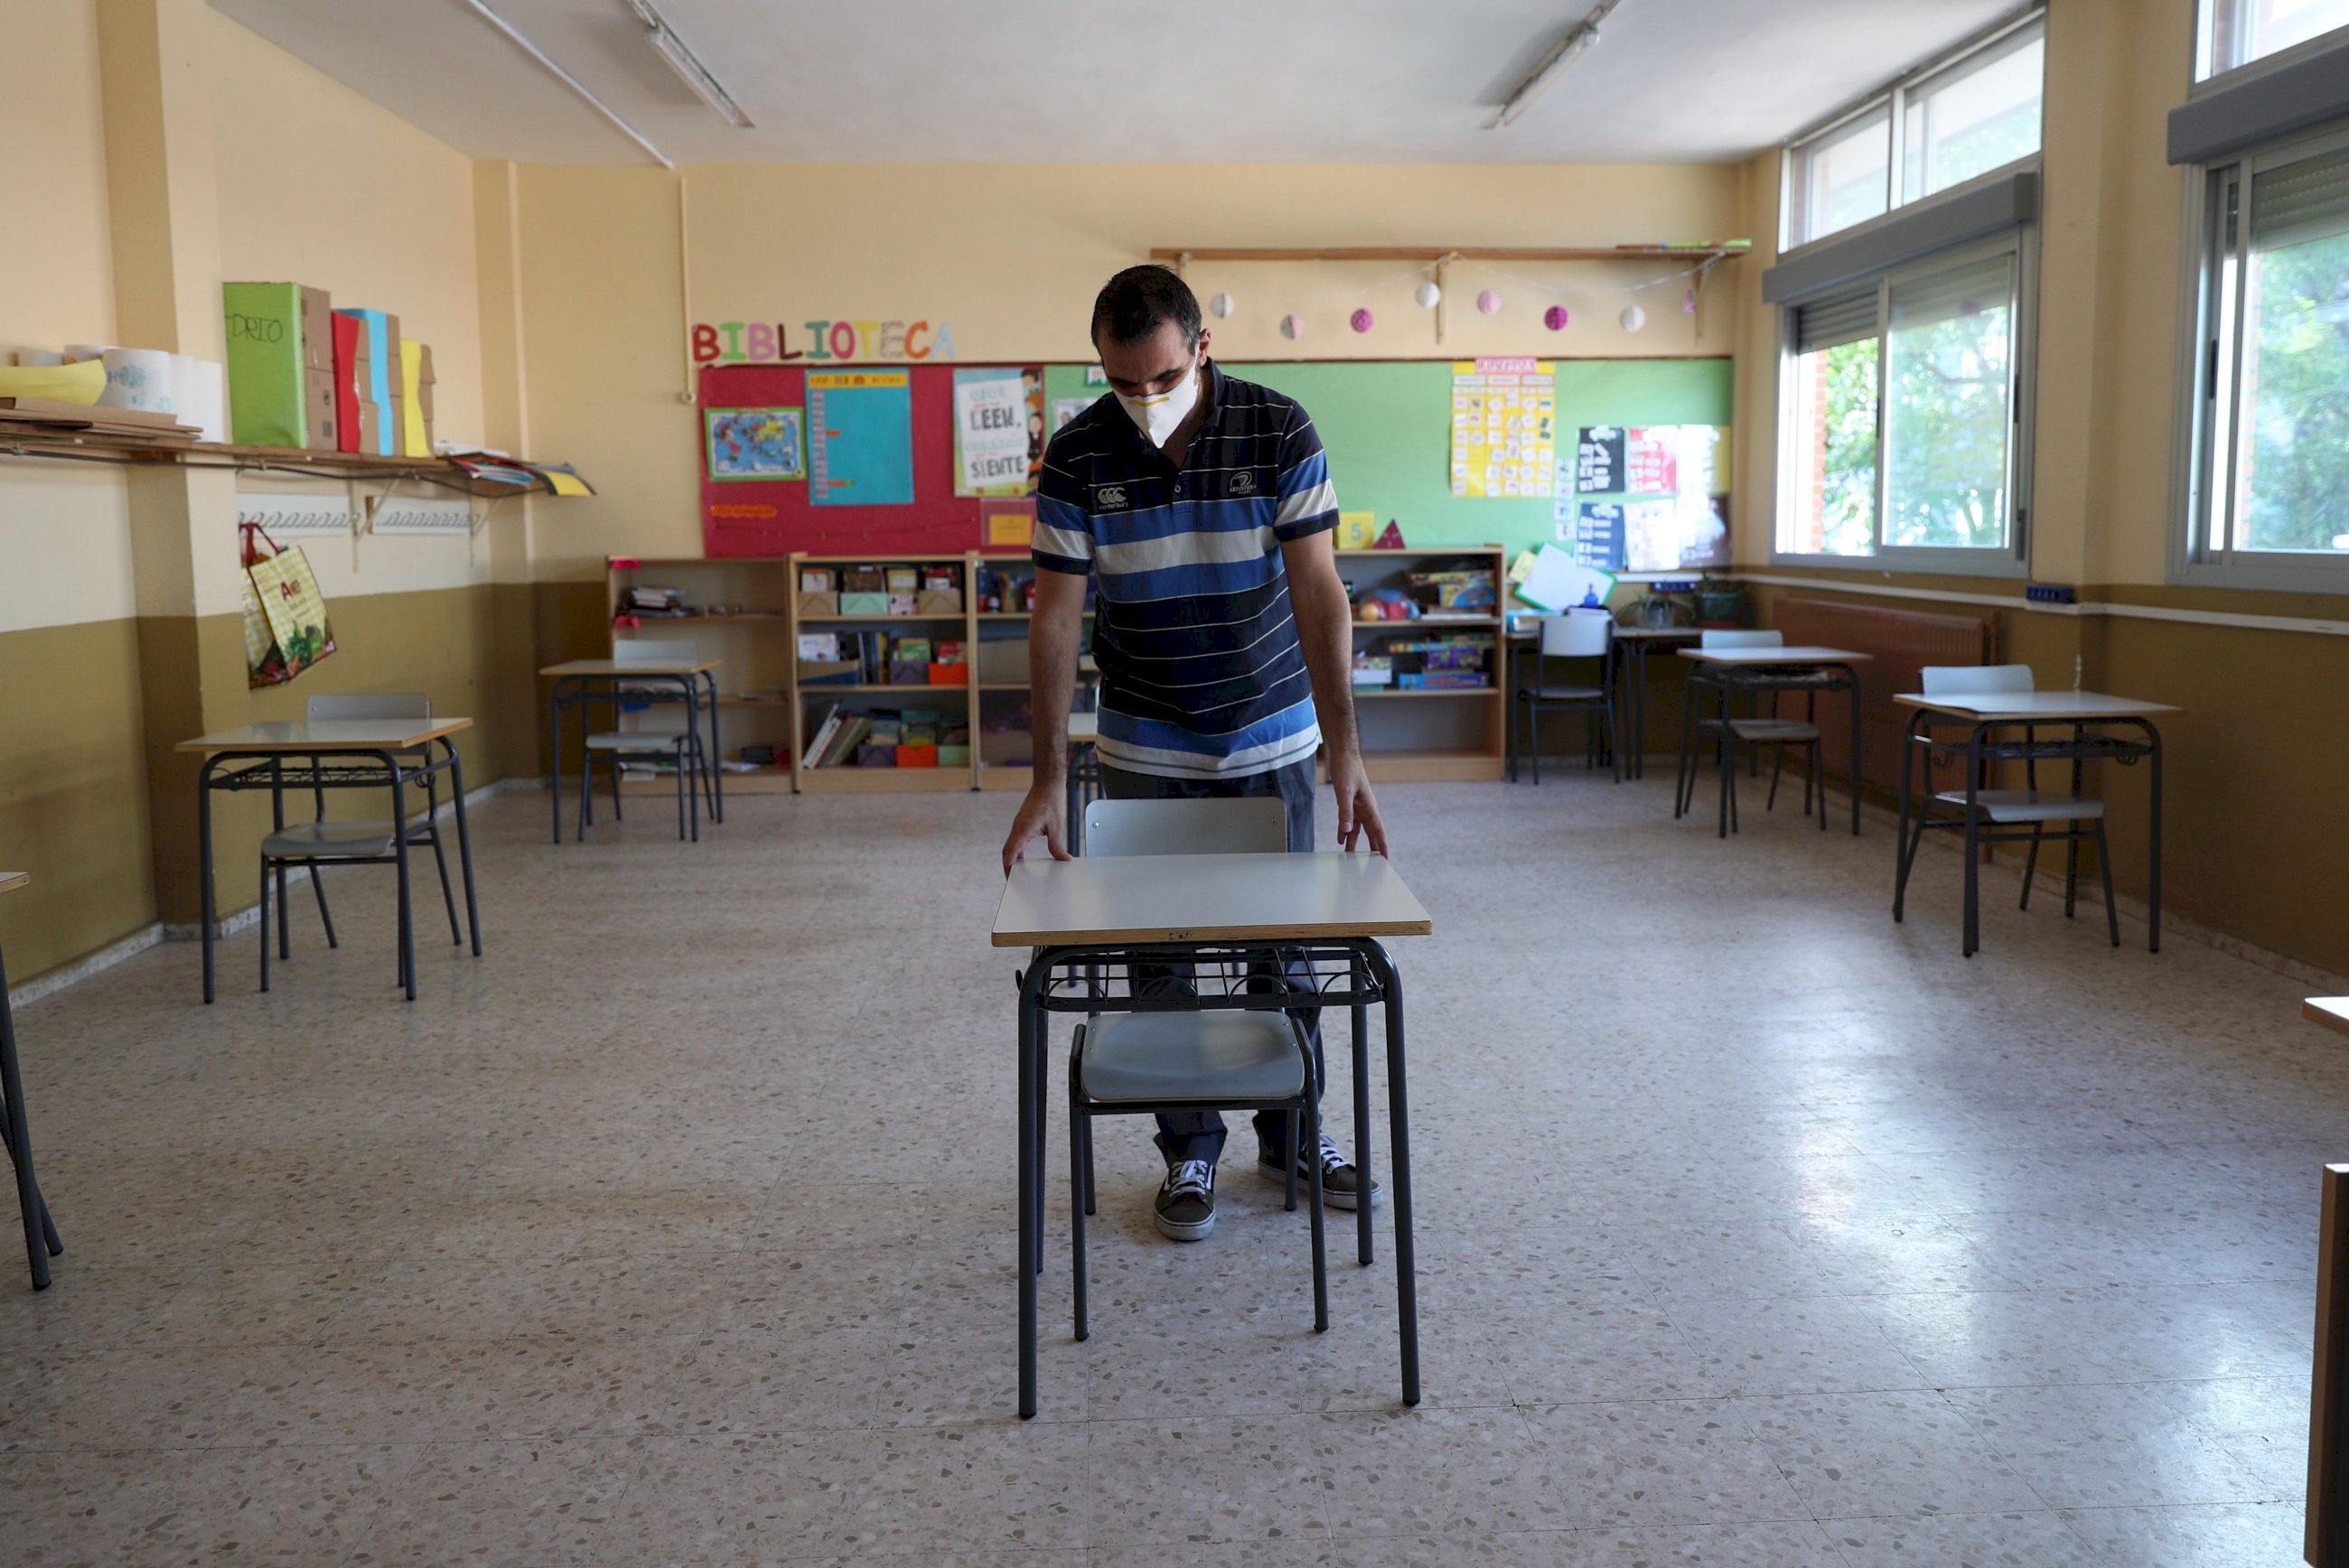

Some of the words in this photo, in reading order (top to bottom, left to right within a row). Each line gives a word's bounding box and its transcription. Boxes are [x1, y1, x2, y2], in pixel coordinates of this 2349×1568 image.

[692, 321, 956, 362] BIBLIOTECA
[971, 456, 1025, 479] SIENTE
[1351, 522, 1362, 542] 5
